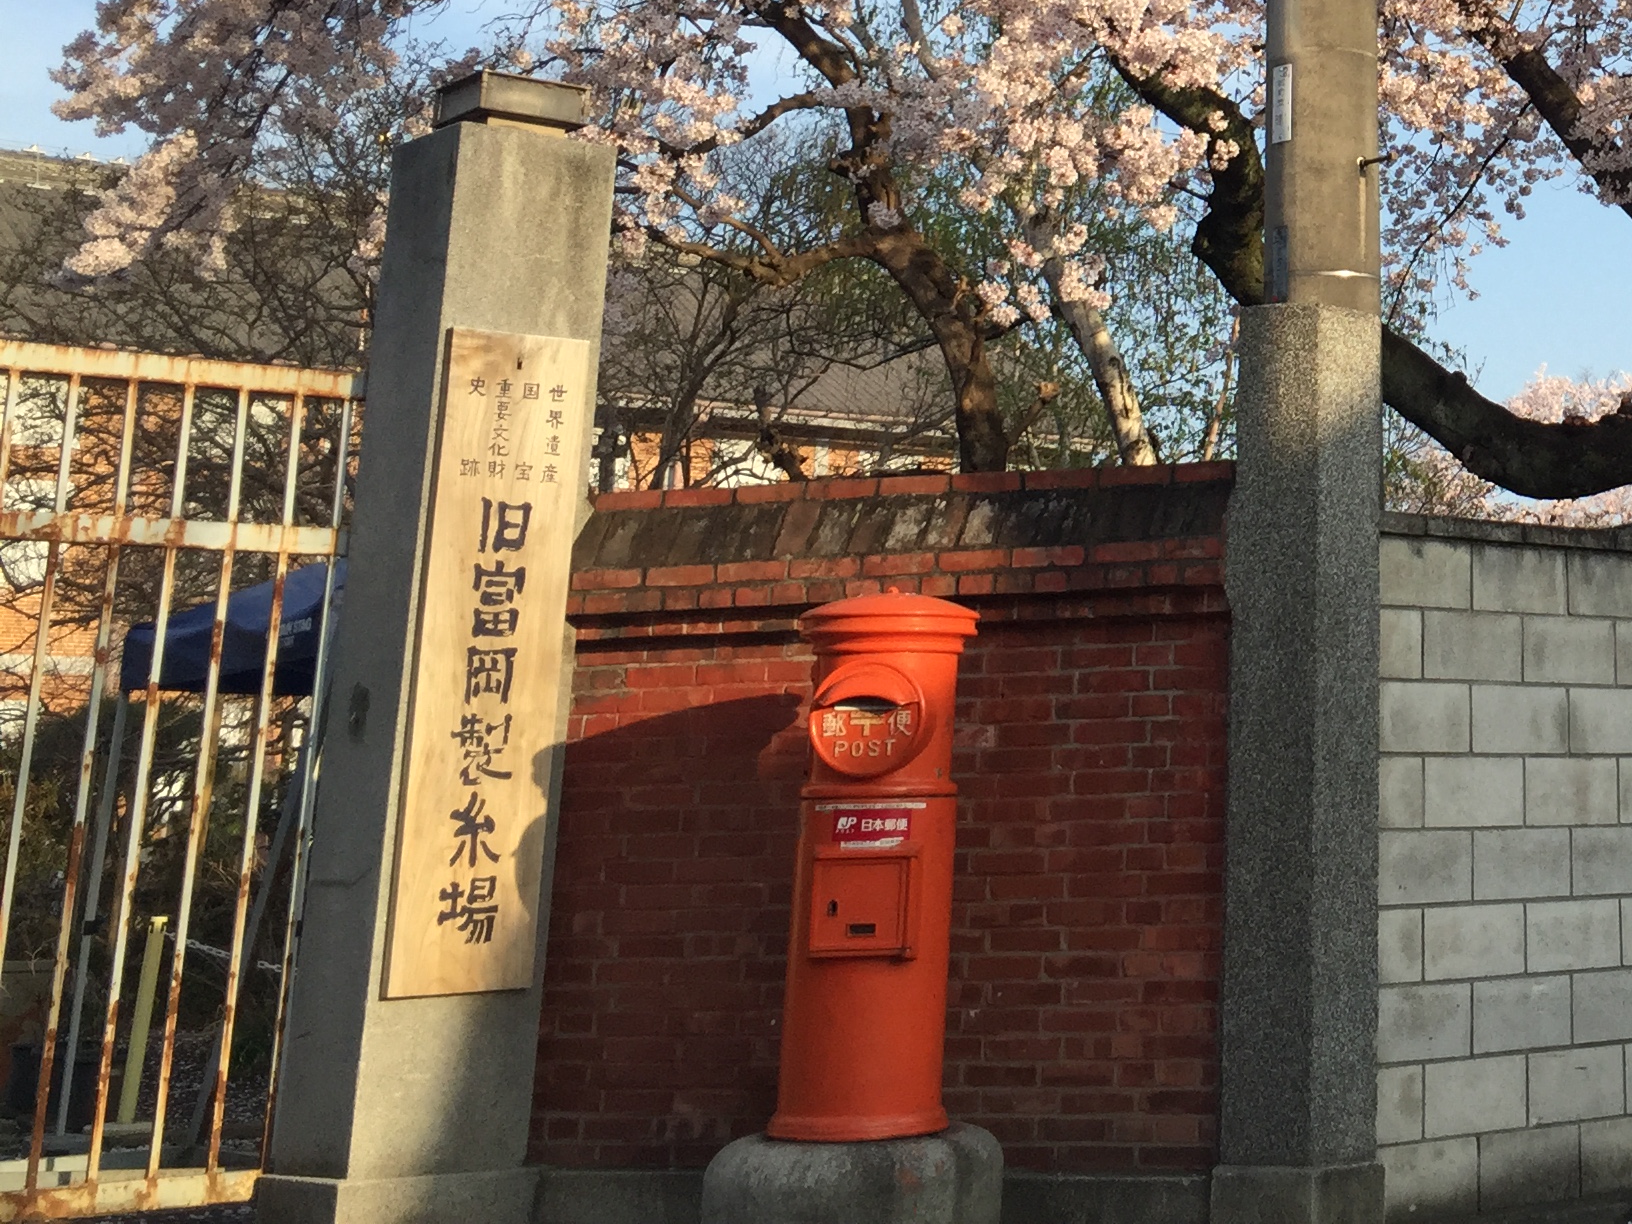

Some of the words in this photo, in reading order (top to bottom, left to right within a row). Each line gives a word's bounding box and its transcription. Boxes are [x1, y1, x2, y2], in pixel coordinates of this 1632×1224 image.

[459, 376, 487, 478] 史跡
[488, 379, 514, 480] 重要文化財
[514, 382, 541, 482] 国宝
[539, 383, 568, 485] 世界遺産
[436, 496, 533, 946] 旧富岡製糸場
[834, 739, 897, 758] POST
[861, 817, 909, 832] 日本郵便
